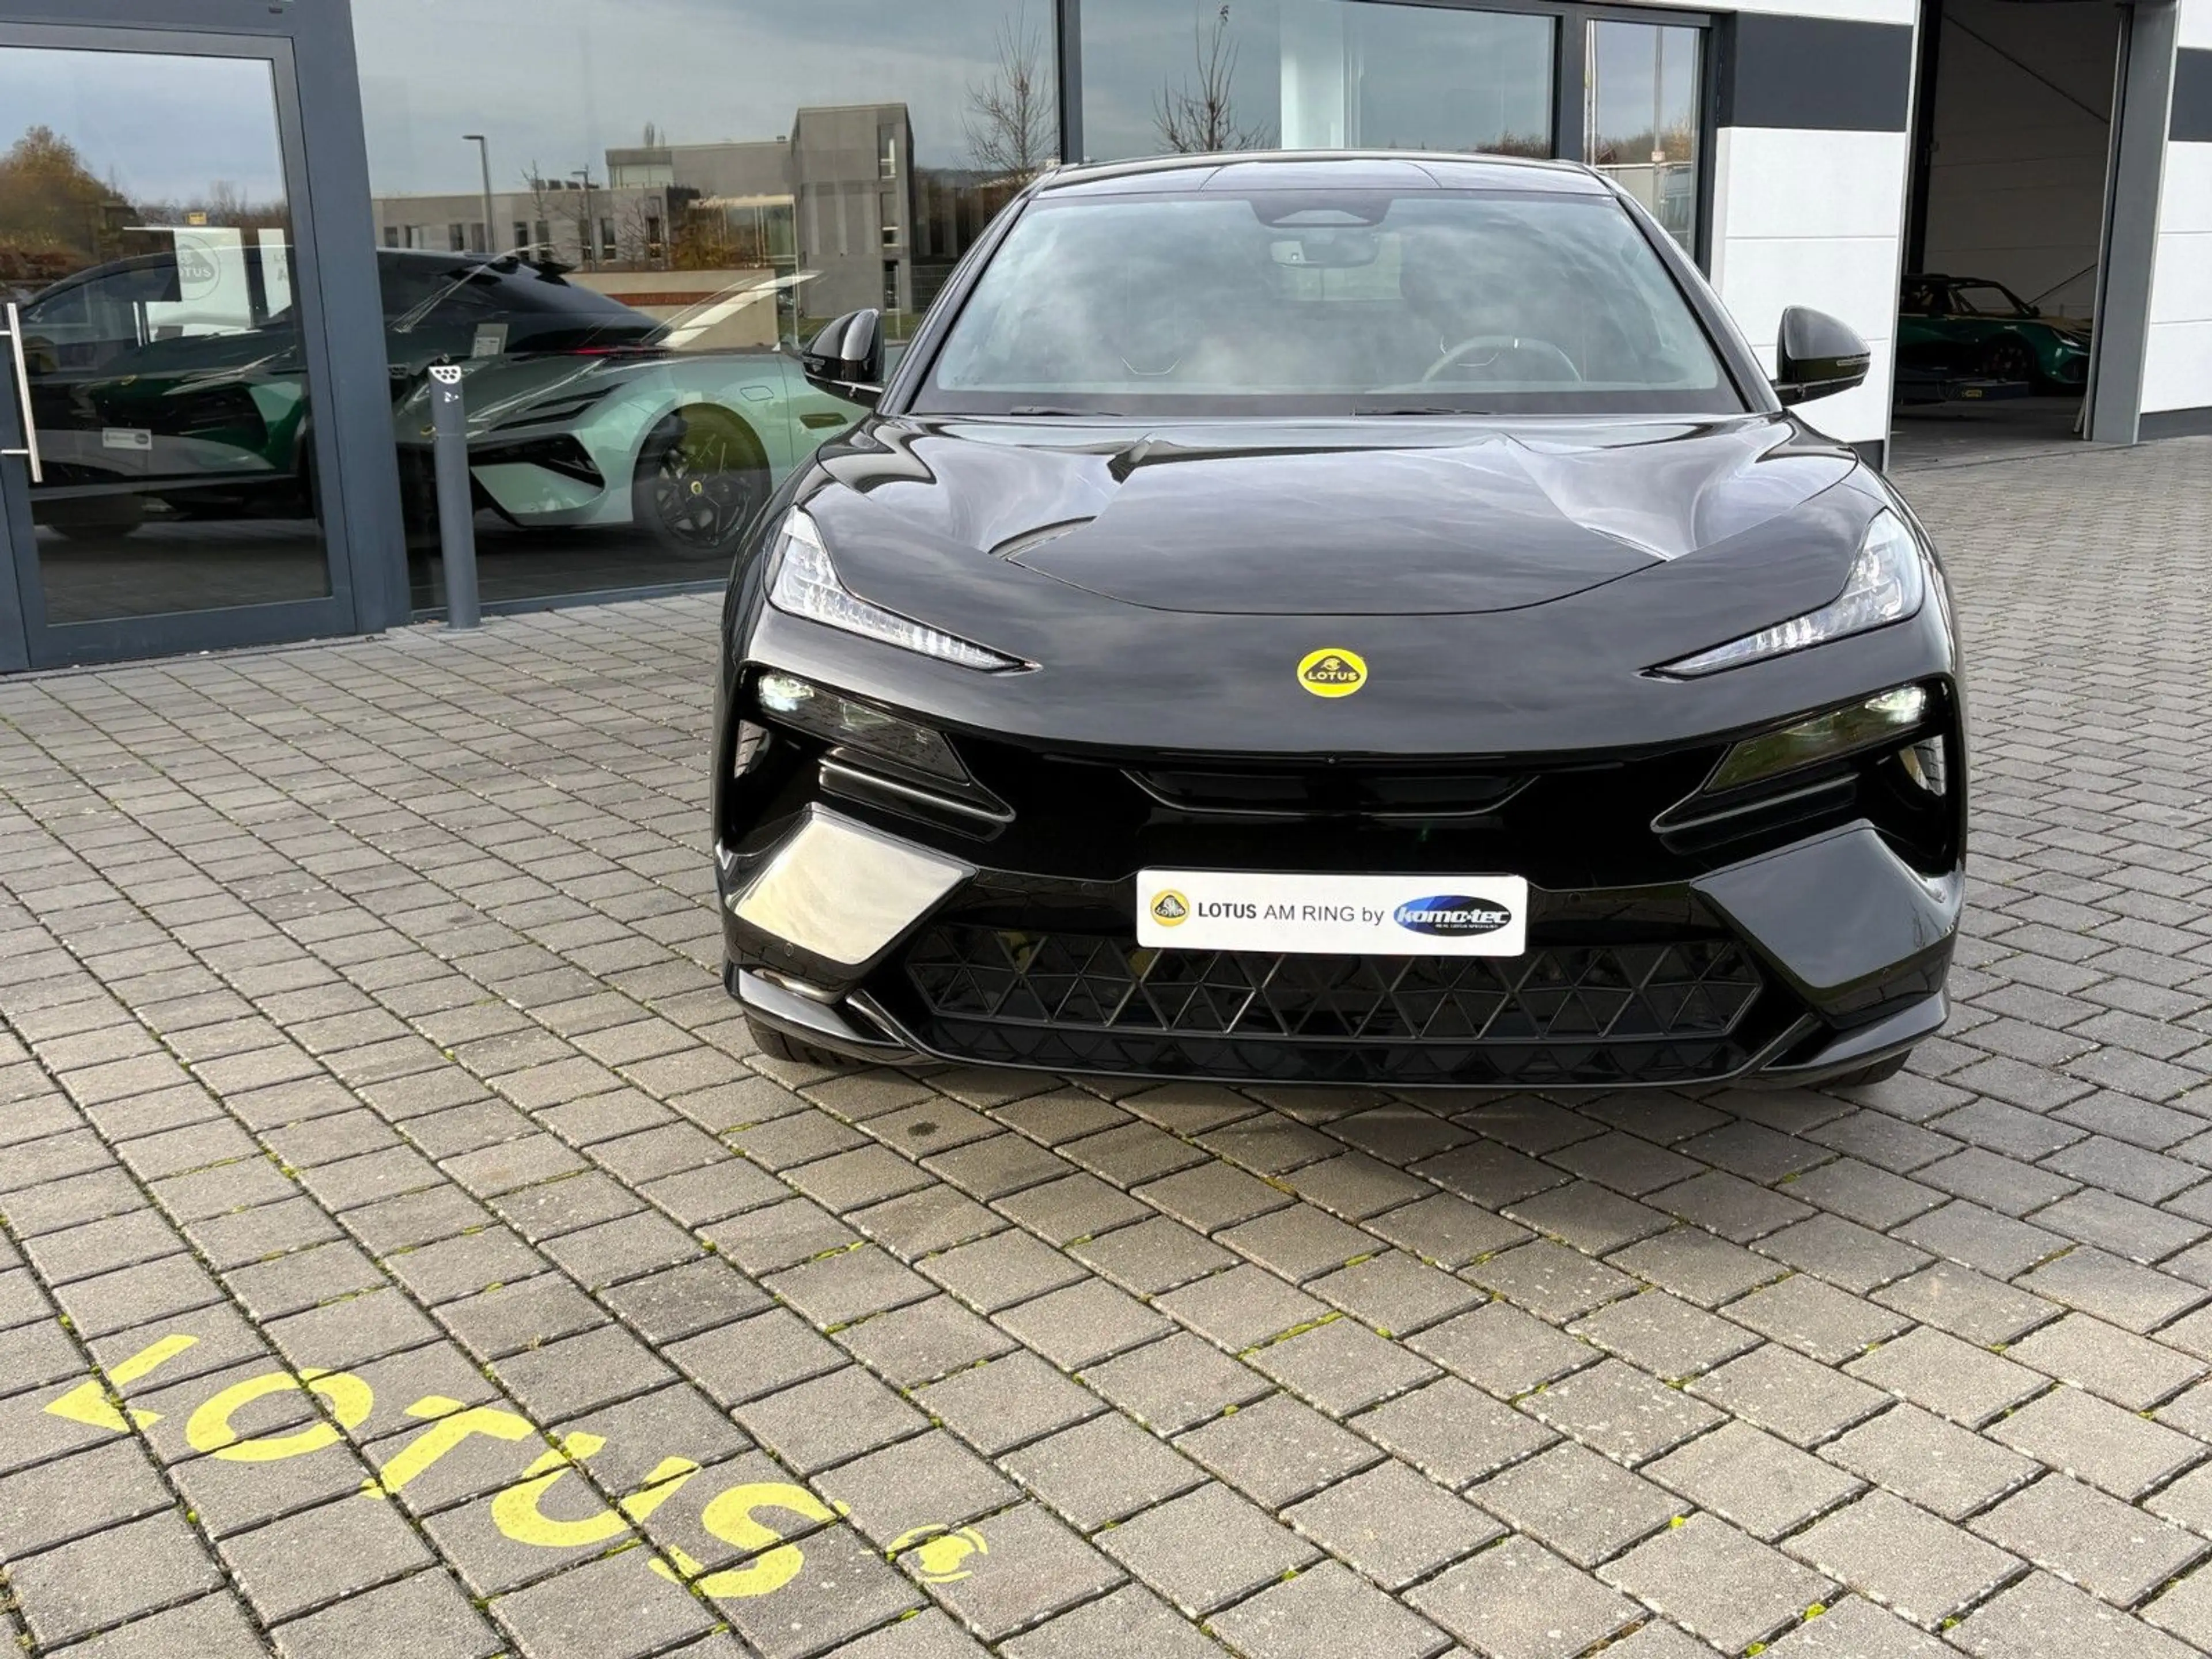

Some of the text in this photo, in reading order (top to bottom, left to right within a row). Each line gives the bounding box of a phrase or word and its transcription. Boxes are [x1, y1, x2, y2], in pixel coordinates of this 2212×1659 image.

[1308, 671, 1357, 681] LOTUS
[1198, 903, 1256, 919] LOTUS
[1264, 905, 1294, 919] AM
[1303, 906, 1354, 921] RING
[1362, 907, 1384, 925] by
